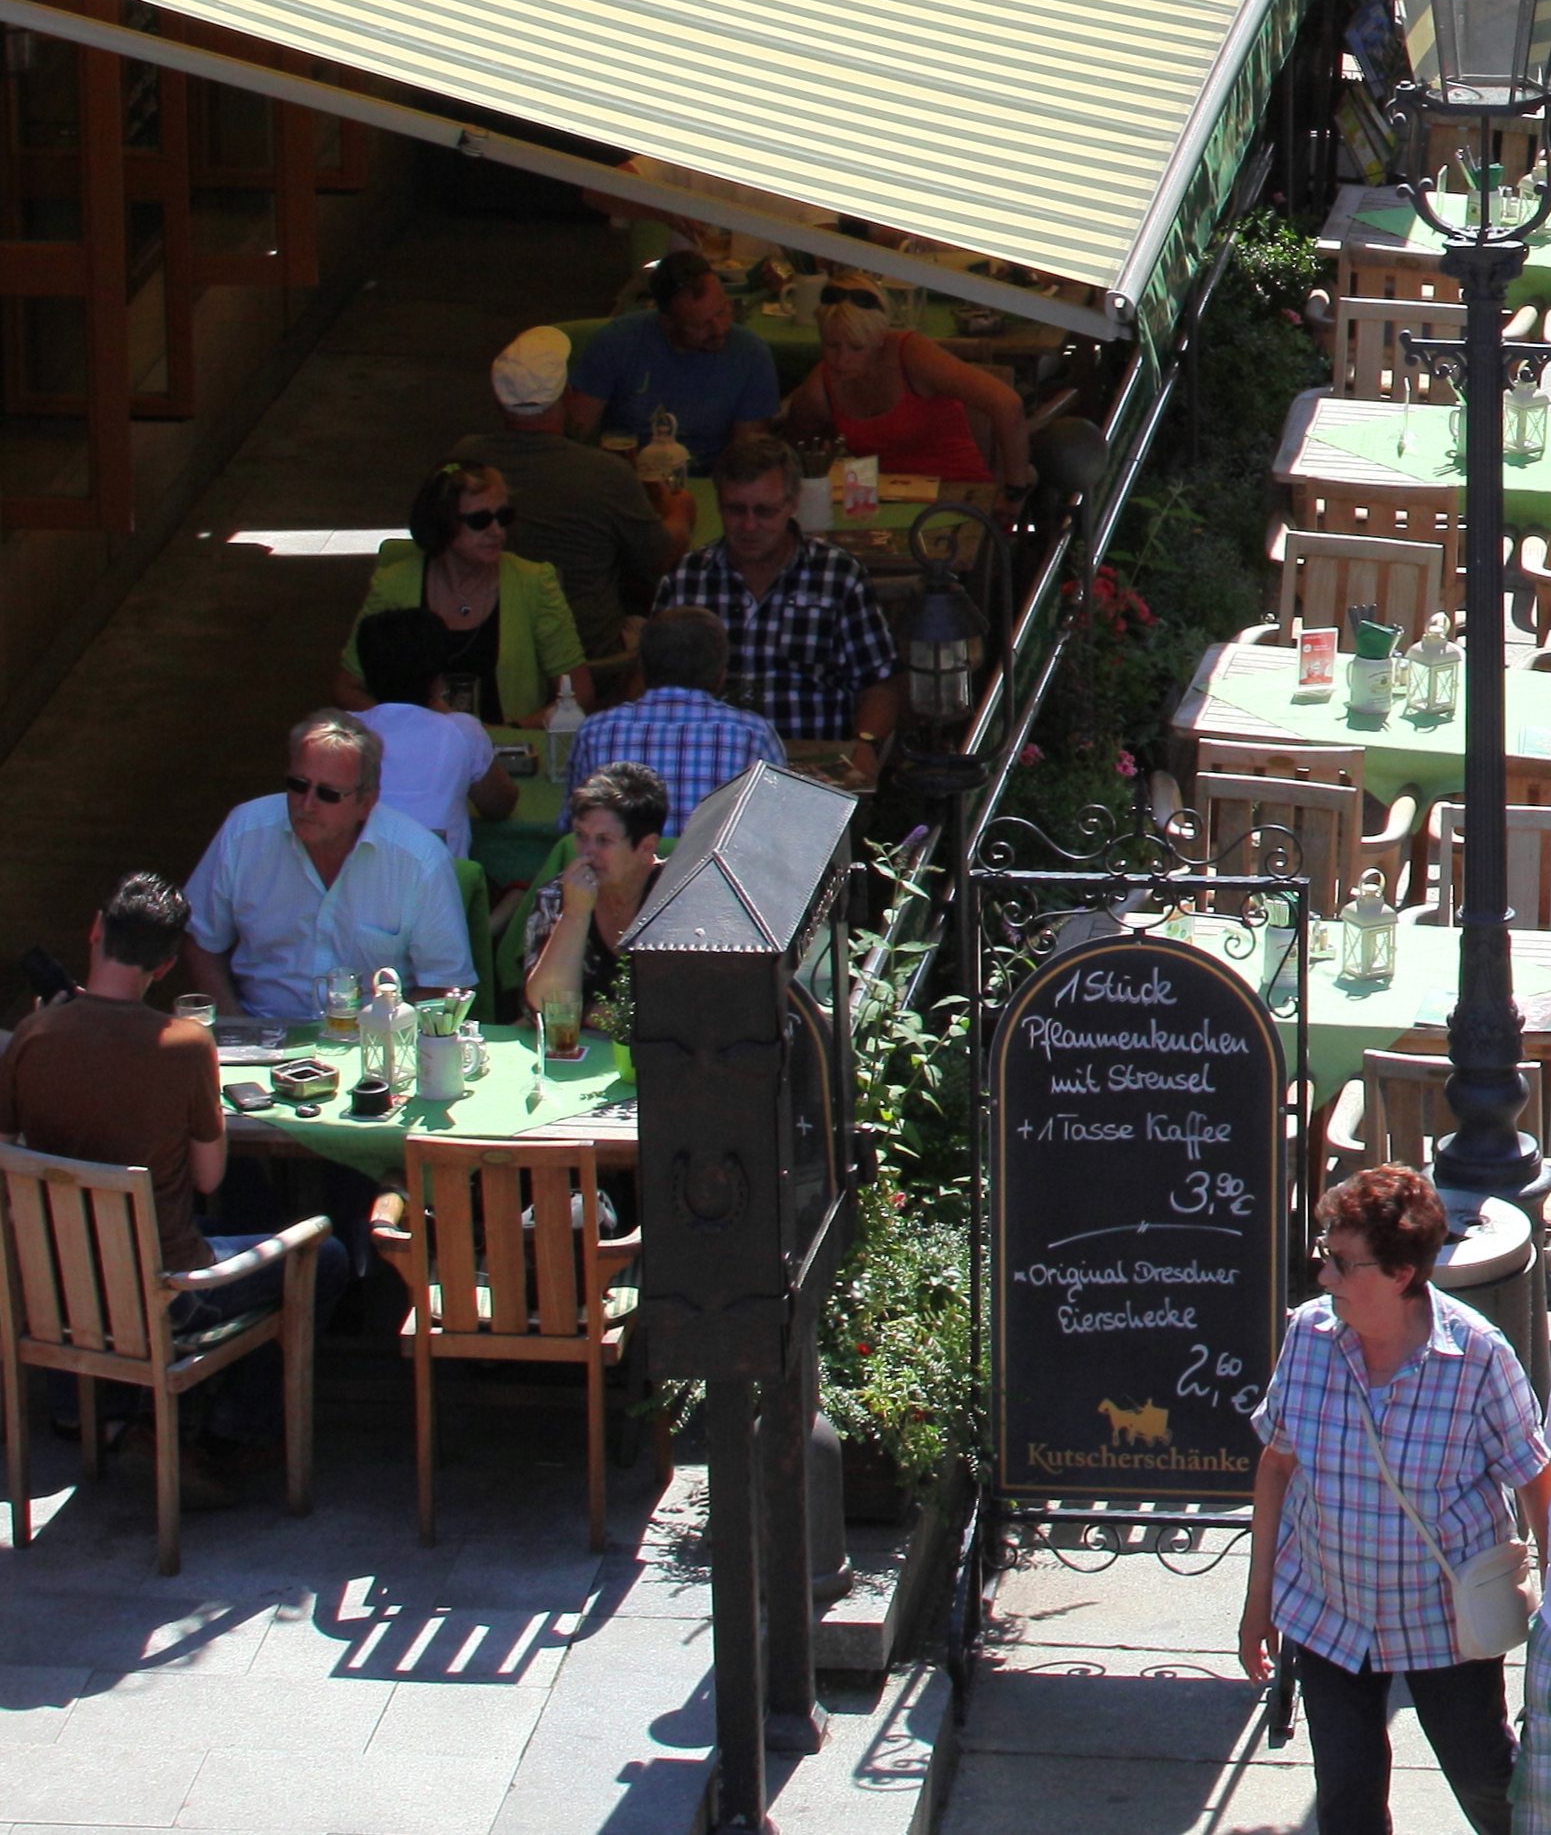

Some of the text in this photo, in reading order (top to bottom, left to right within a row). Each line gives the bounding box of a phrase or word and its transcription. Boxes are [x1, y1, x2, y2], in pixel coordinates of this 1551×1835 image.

[1054, 966, 1178, 1008] 1 Stück
[1021, 1015, 1249, 1062] Pflaumenkuchen
[1051, 1063, 1216, 1095] mit Streusel
[1056, 1113, 1136, 1142] Tasse
[1147, 1111, 1232, 1160] Kaffee
[1133, 1260, 1239, 1287] Dresdner
[1057, 1298, 1198, 1334] Eierschecke
[1026, 1442, 1250, 1475] Kutscherschänke
